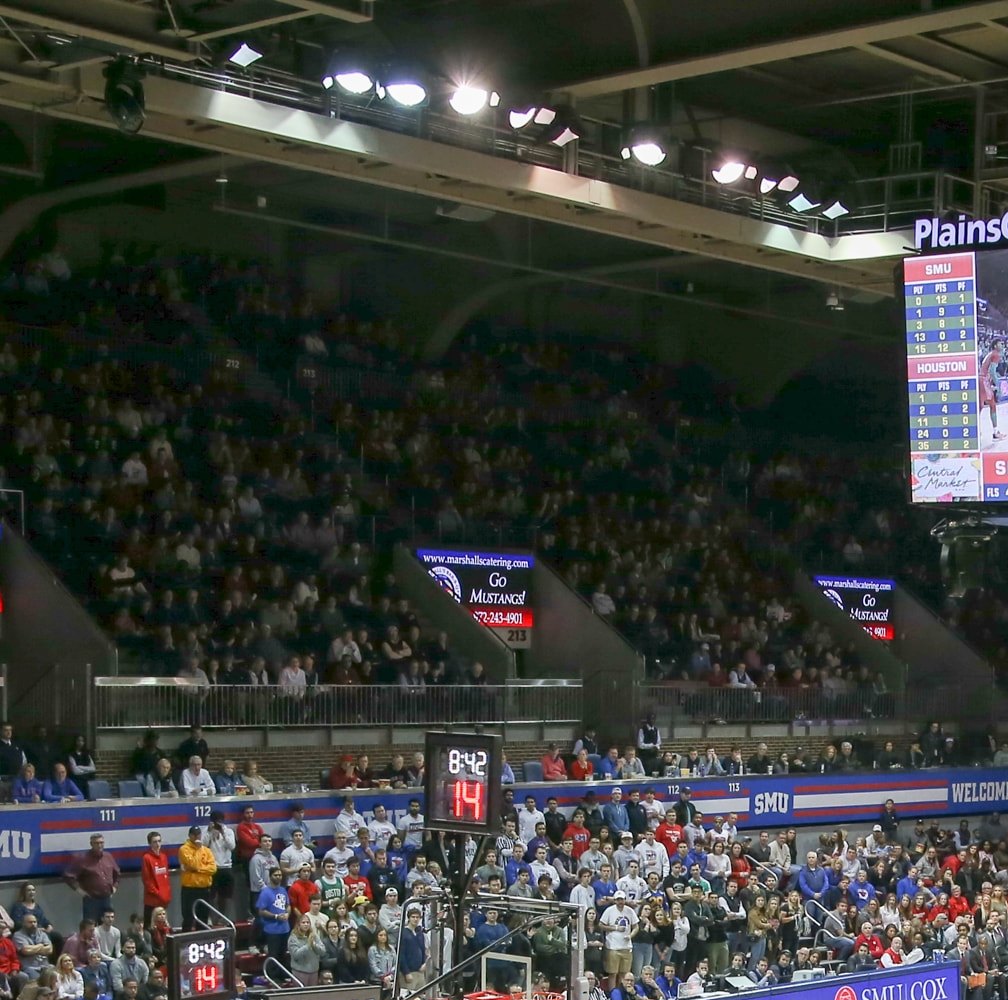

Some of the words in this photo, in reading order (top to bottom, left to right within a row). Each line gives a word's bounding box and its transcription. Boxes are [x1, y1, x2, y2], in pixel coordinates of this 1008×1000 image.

[926, 263, 952, 275] SMU
[914, 286, 923, 294] PLY
[935, 283, 946, 293] PTS
[958, 282, 965, 291] PF
[916, 297, 921, 305] 0
[936, 295, 947, 304] 12
[959, 294, 964, 302] 1
[916, 309, 921, 317] 1
[939, 307, 944, 316] 9
[960, 306, 964, 314] 1
[916, 321, 922, 329] 3
[960, 318, 965, 326] 1
[914, 333, 926, 342] 13
[940, 332, 945, 340] 0
[960, 330, 966, 339] 2
[914, 344, 926, 354] 15
[938, 343, 948, 352] 12
[961, 342, 966, 350] 1
[918, 361, 967, 374] HOUSTON
[938, 381, 950, 390] PTS
[961, 381, 968, 390] PF
[962, 392, 968, 400] 0
[917, 465, 964, 479] Central
[924, 478, 976, 490] Market
[987, 488, 999, 497] FLS
[424, 555, 528, 570] www.marshallscatering.com
[489, 573, 506, 587] Go
[863, 594, 875, 606] Go
[508, 630, 526, 641] 213
[448, 749, 487, 776] 8:42
[668, 785, 680, 794] 112
[728, 782, 740, 792] 113
[452, 780, 484, 821] 14
[754, 792, 788, 815] SMU
[100, 810, 116, 822] 111
[194, 806, 211, 817] 112
[188, 940, 226, 964] 8:42
[195, 966, 218, 992] 14
